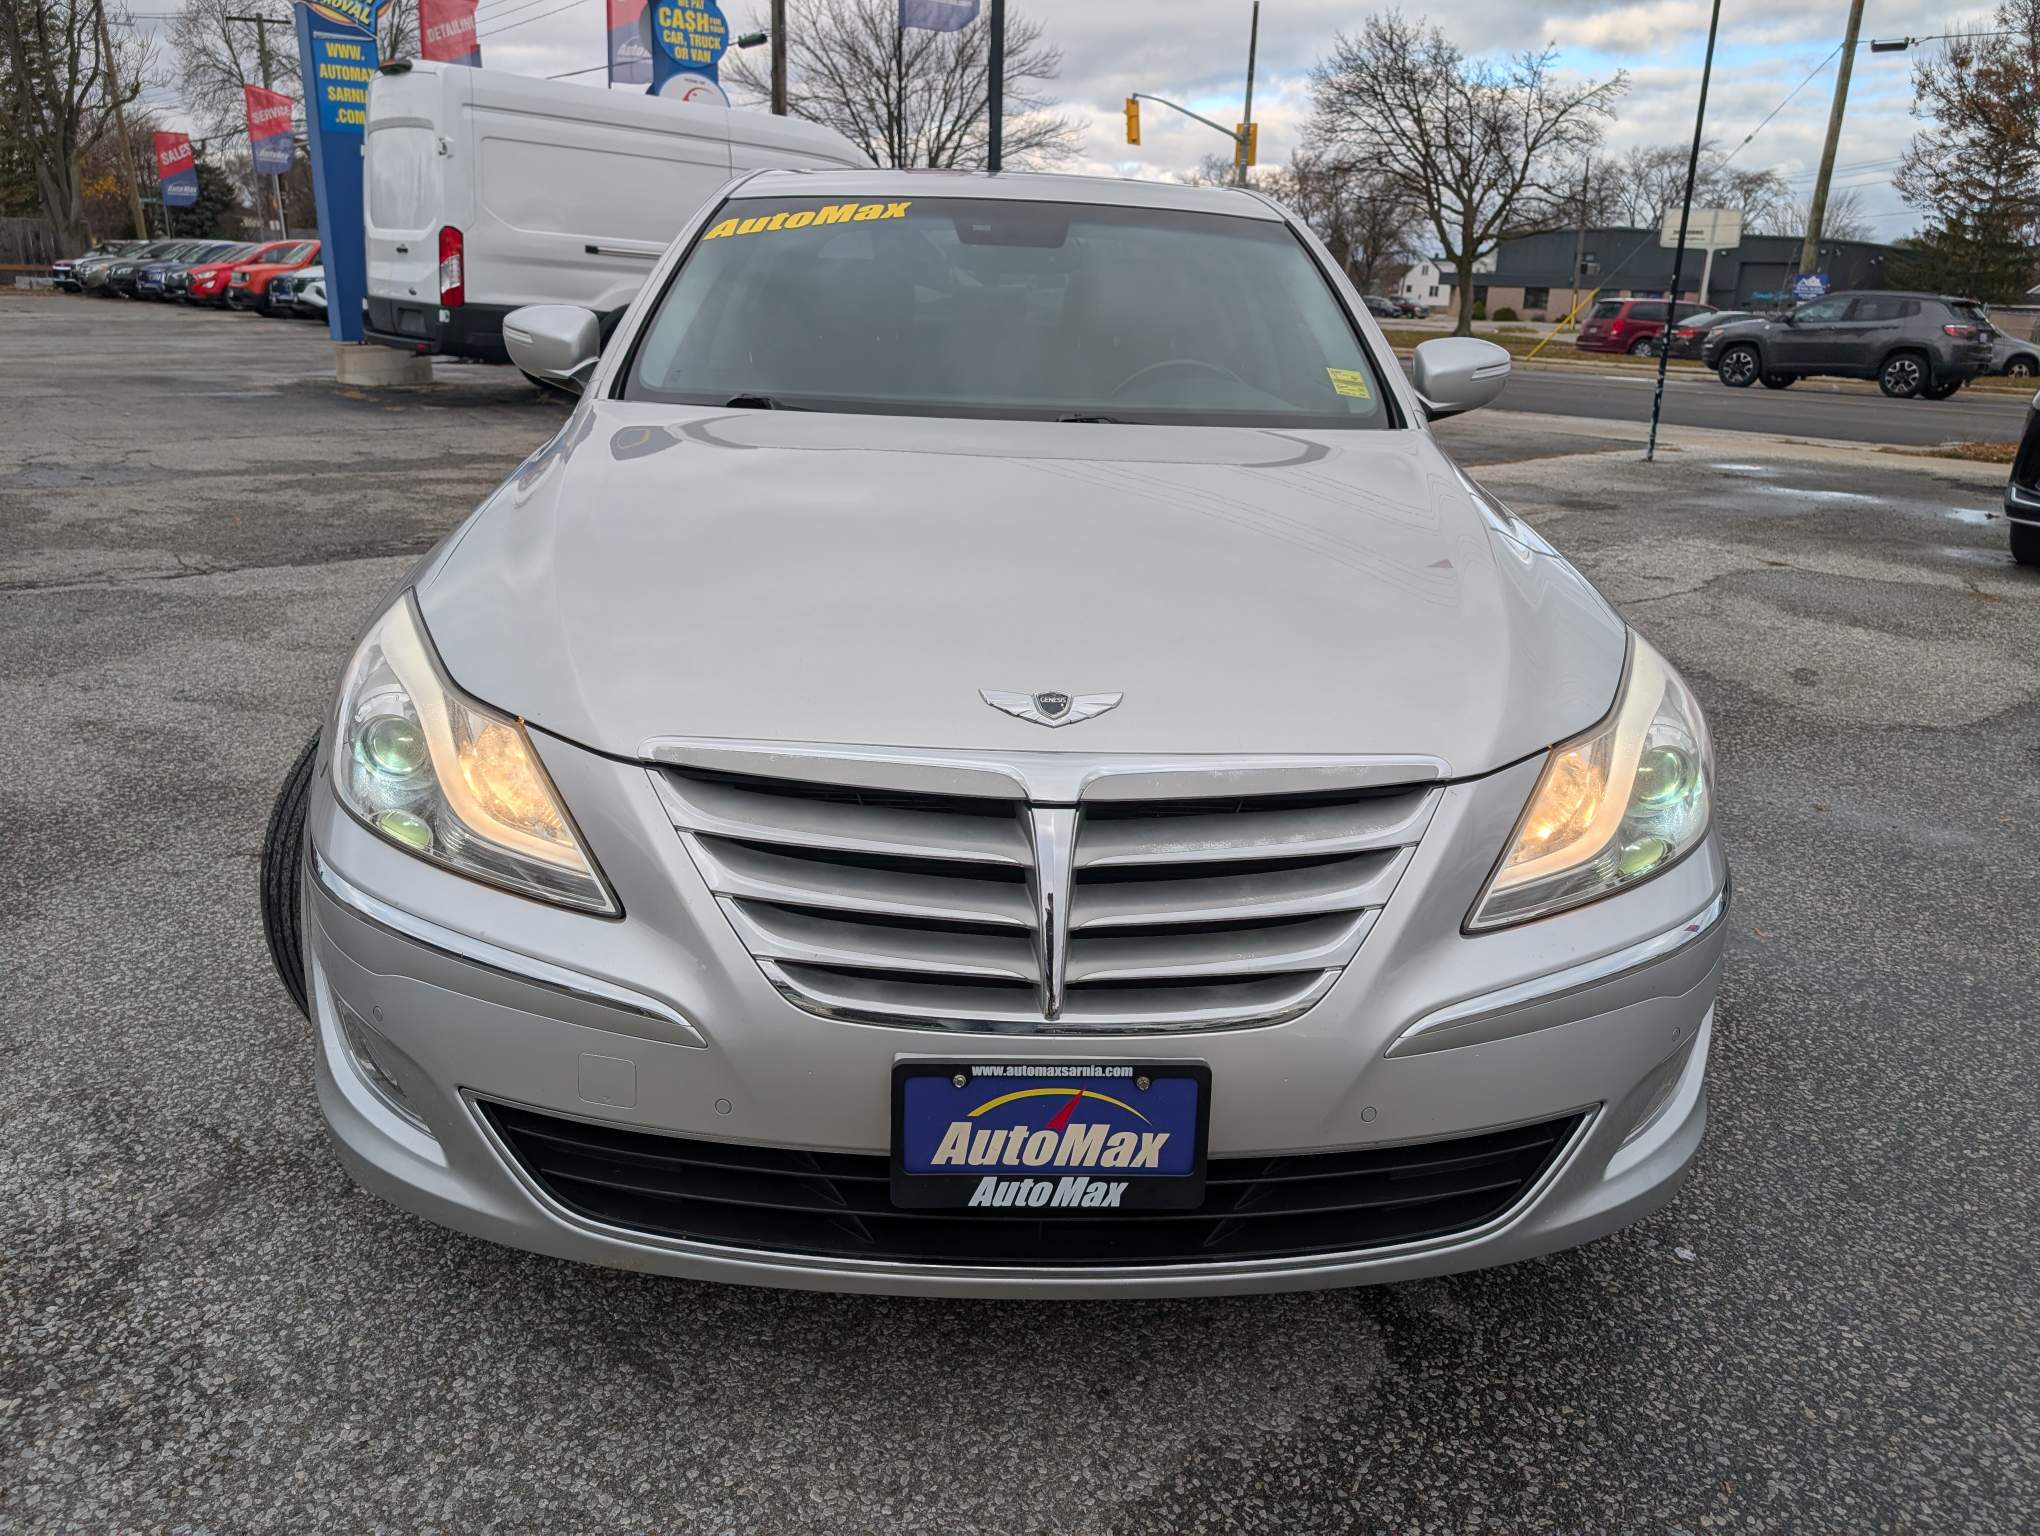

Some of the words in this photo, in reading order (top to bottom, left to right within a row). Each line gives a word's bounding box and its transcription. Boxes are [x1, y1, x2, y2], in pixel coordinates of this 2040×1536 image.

[663, 30, 688, 46] CAR,
[689, 33, 721, 50] TRUCK
[325, 42, 365, 61] WWW.
[674, 47, 688, 60] OR
[691, 48, 711, 64] VAN
[252, 105, 290, 123] SERVICE
[336, 107, 366, 125] .COM
[160, 143, 192, 166] SALES
[703, 202, 912, 240] AutoMax
[971, 1065, 1133, 1078] www.automaxsarnia.com
[930, 1121, 1170, 1169] AutoMax
